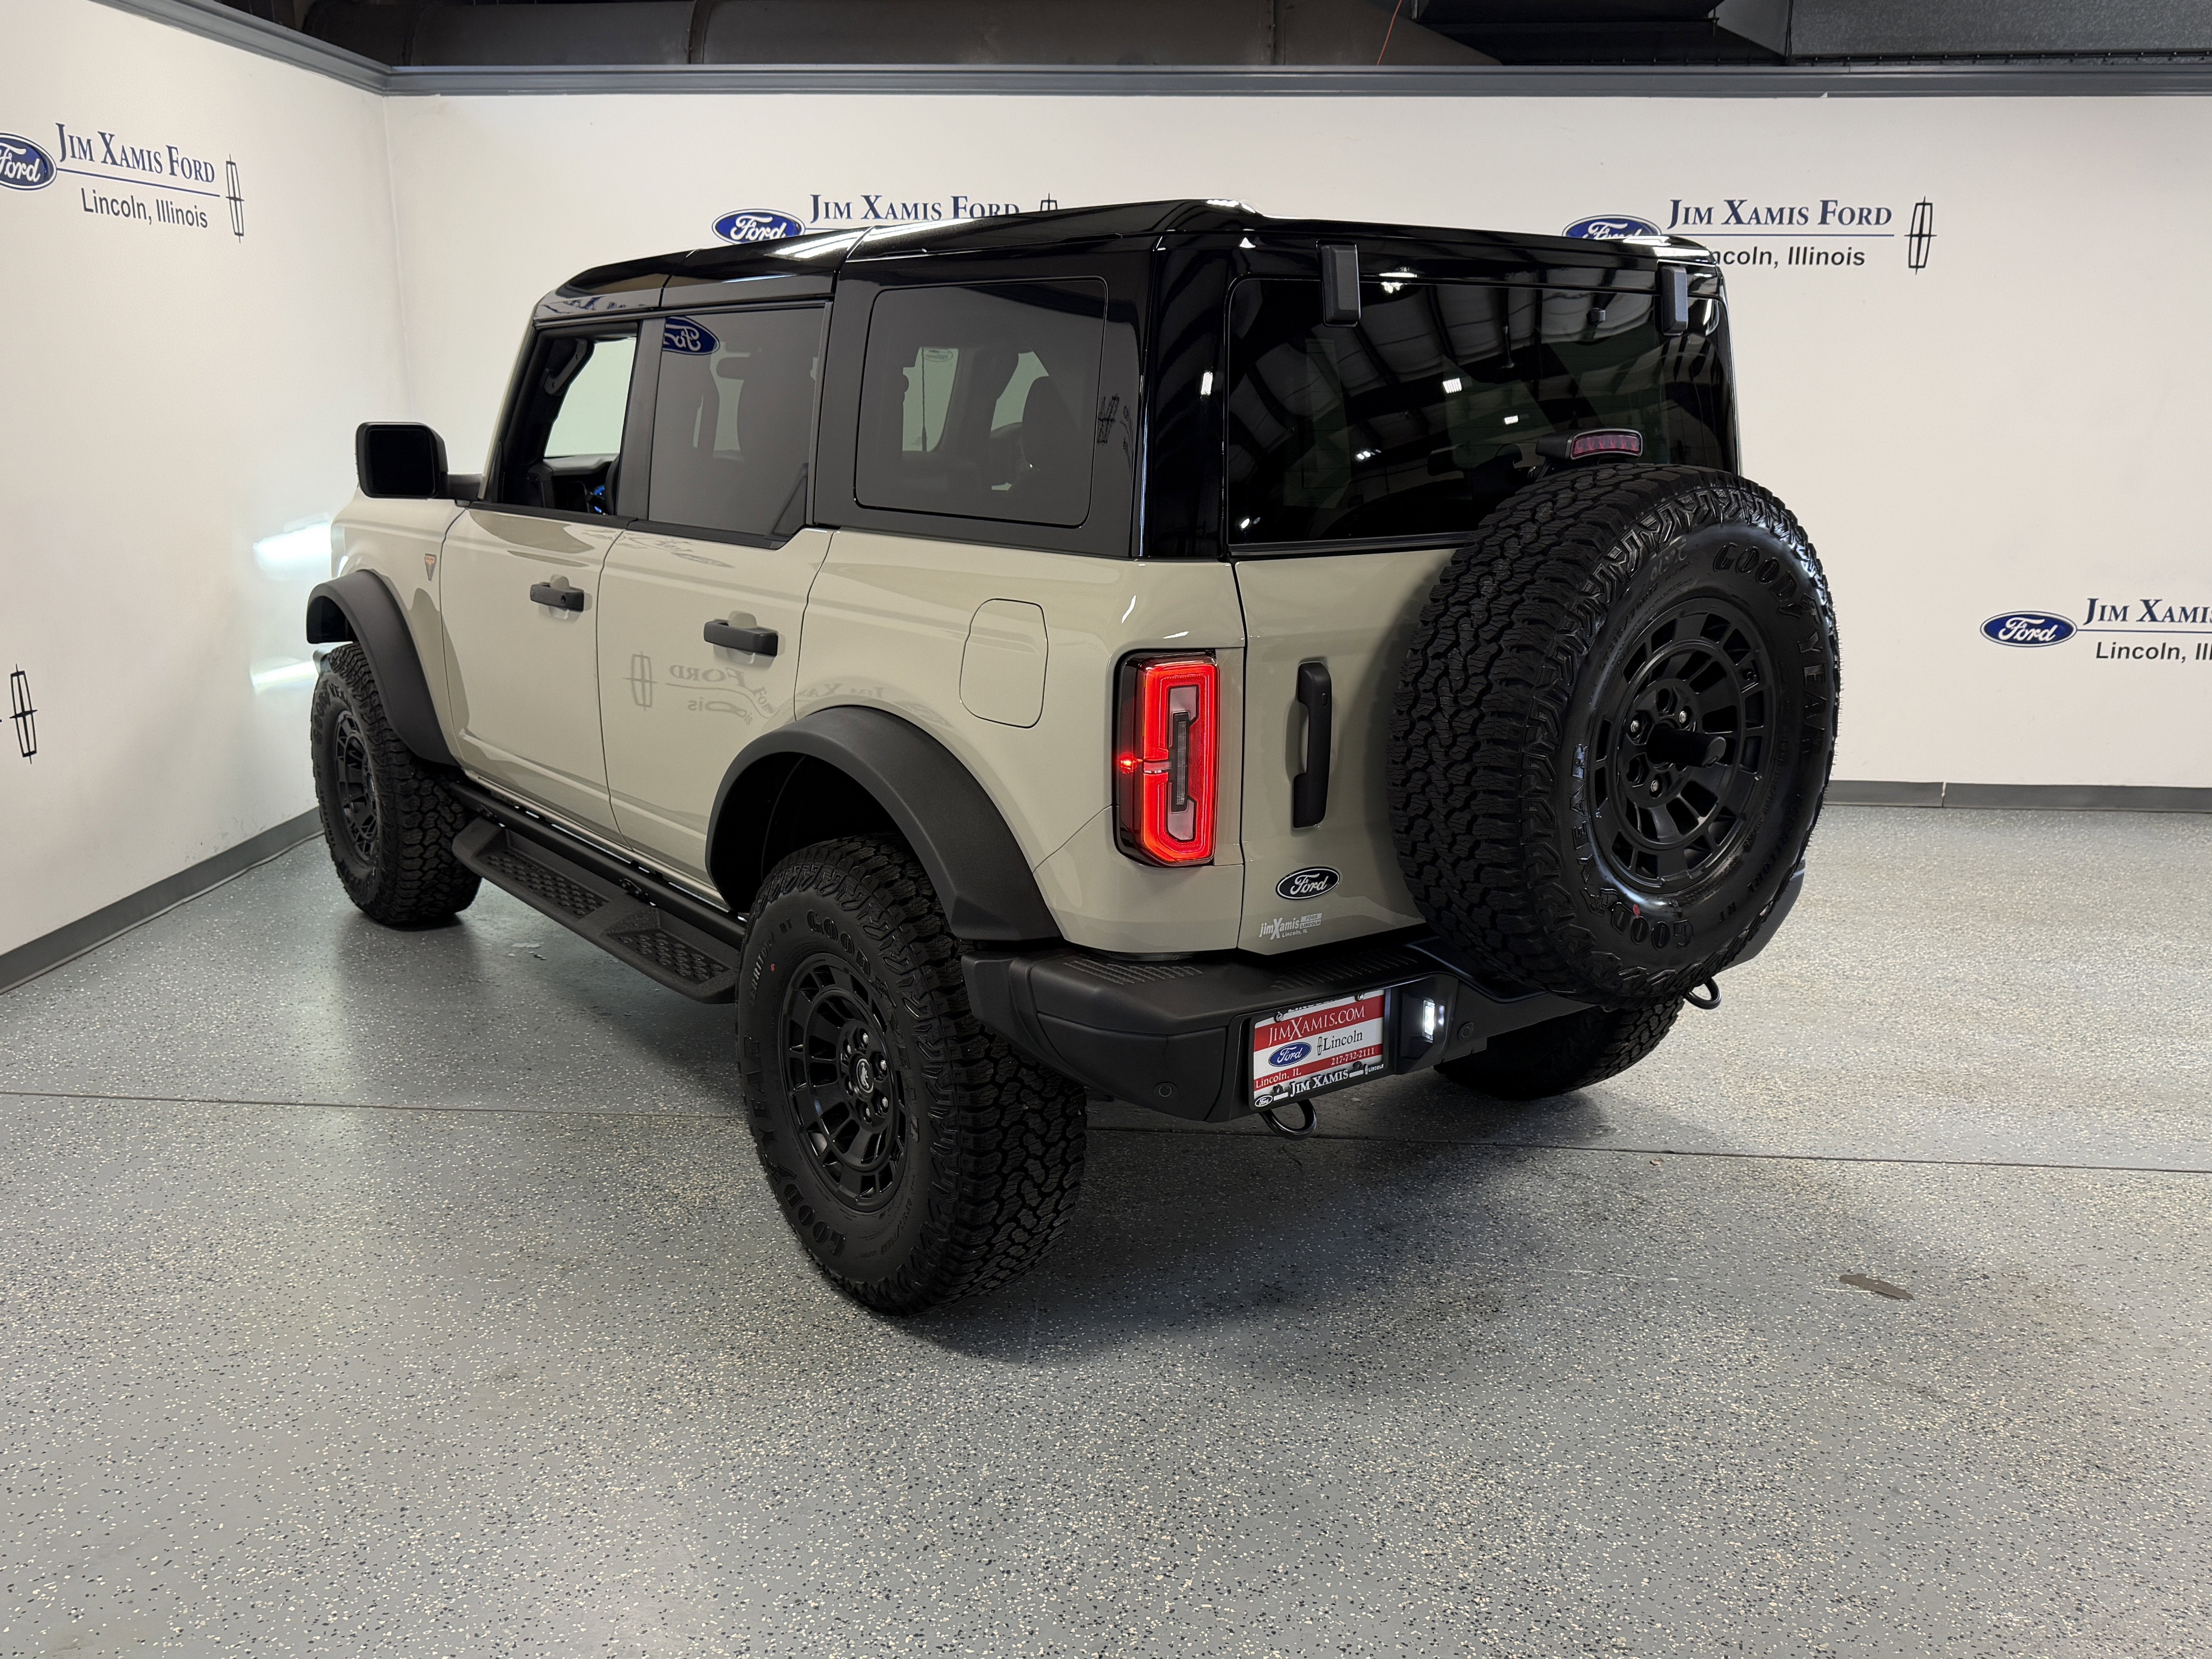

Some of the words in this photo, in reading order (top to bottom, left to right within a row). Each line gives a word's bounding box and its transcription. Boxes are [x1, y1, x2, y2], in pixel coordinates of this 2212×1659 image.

[81, 188, 152, 225] Lincoln,
[156, 199, 208, 228] Illinois
[730, 215, 787, 241] Ford
[1710, 246, 1778, 269] ncoln,
[1788, 246, 1865, 266] Illinois
[2136, 599, 2212, 623] XAMI
[1998, 617, 2058, 641] Ford
[2096, 642, 2186, 663] Lincoln,
[1290, 873, 1329, 895] Ford
[1323, 1030, 1363, 1051] Lincoln
[1277, 1045, 1304, 1063] Ford
[1331, 1047, 1374, 1065] 217-732-2111
[1293, 1068, 1302, 1077] IL
